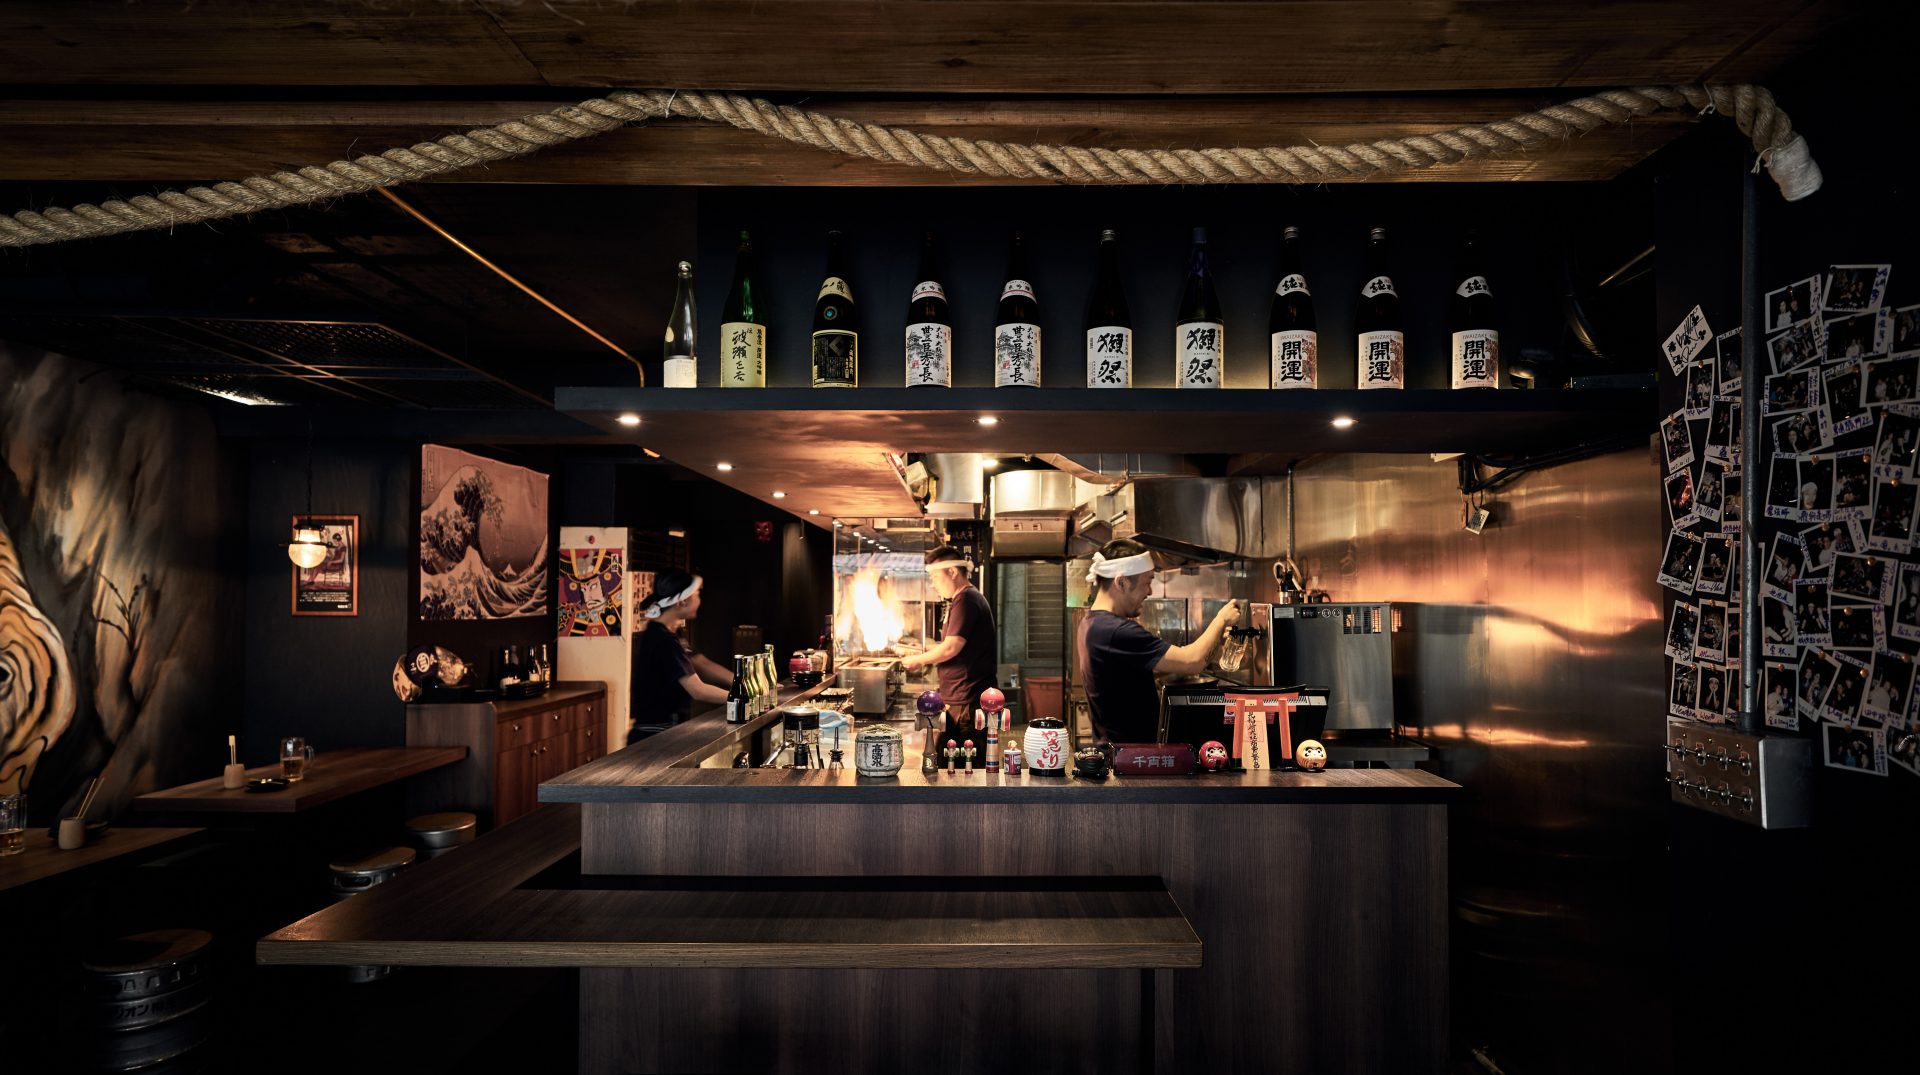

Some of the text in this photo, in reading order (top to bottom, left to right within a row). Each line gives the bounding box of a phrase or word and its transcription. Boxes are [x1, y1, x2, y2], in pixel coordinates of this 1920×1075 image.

[1281, 340, 1304, 382] 開運
[1368, 341, 1392, 382] 開運
[1463, 340, 1487, 381] 開運
[1041, 730, 1062, 769] やきとり
[1132, 755, 1175, 769] 千両箱
